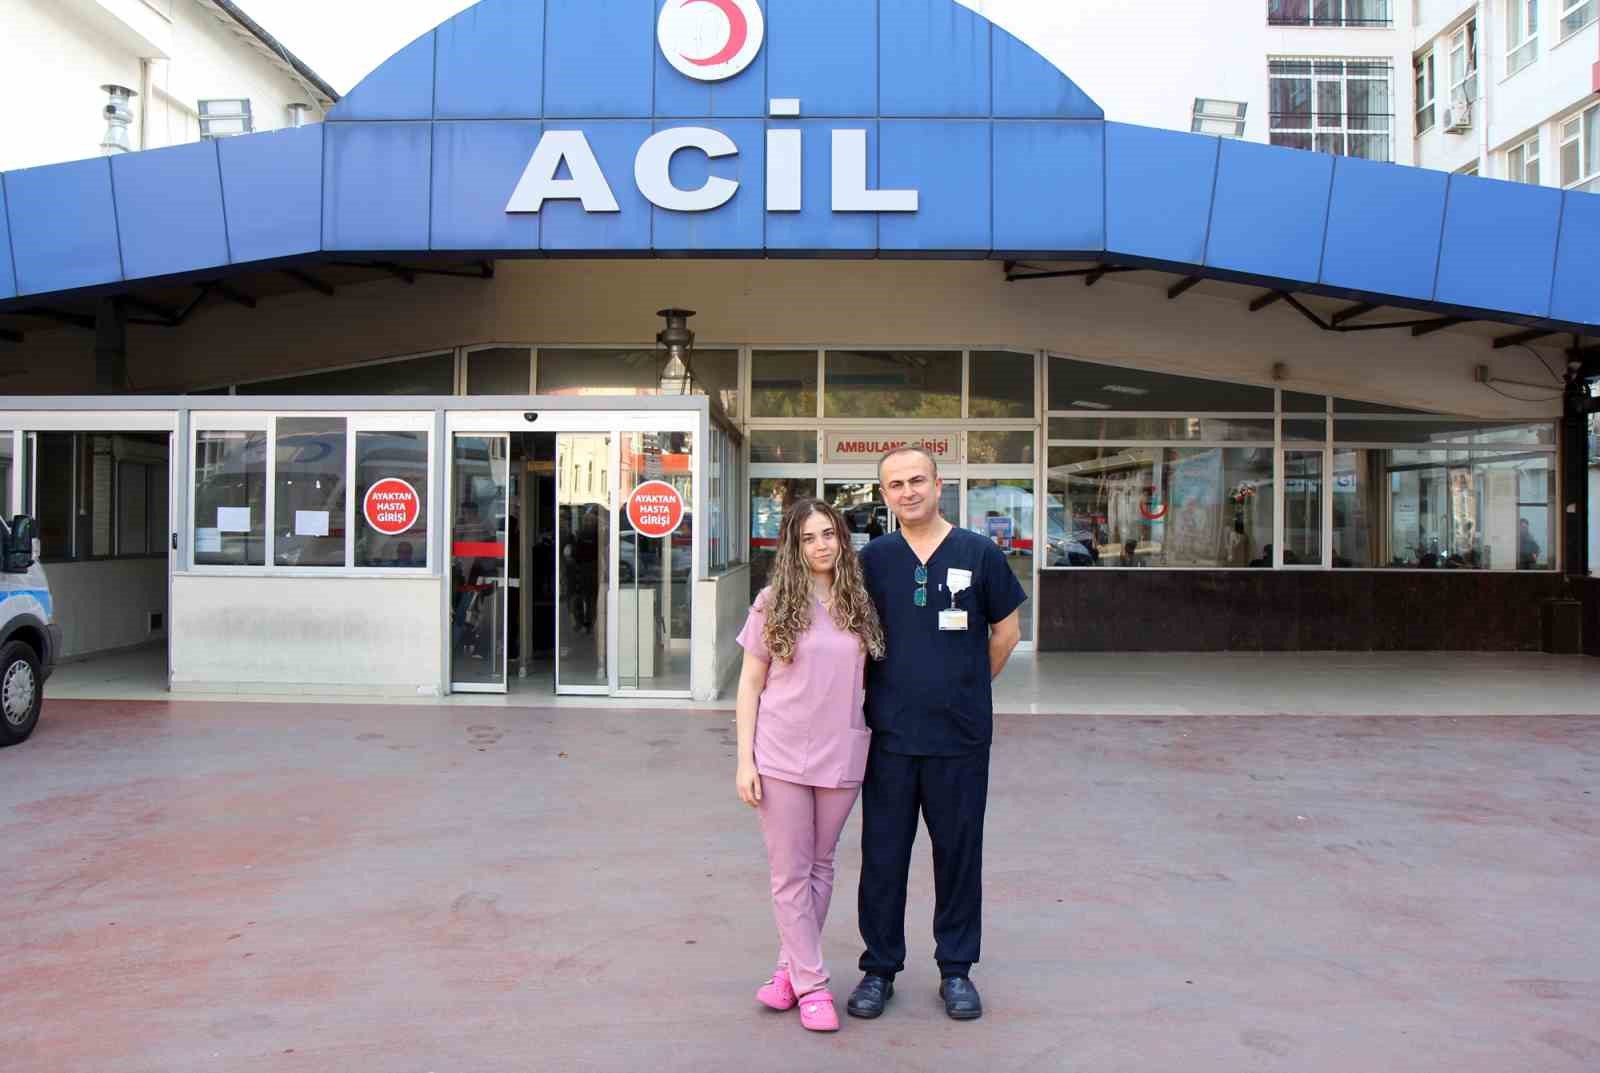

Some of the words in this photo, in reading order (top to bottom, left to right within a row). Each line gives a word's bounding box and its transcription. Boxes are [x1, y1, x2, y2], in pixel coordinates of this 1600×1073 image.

[505, 98, 920, 214] ACİL
[372, 492, 411, 500] AYAKTAN
[635, 495, 676, 503] AYAKTAN
[376, 503, 406, 511] HASTA
[639, 505, 670, 513] HASTA
[376, 511, 406, 524] GİRİŞİ
[640, 514, 671, 527] GİRİŞİ
